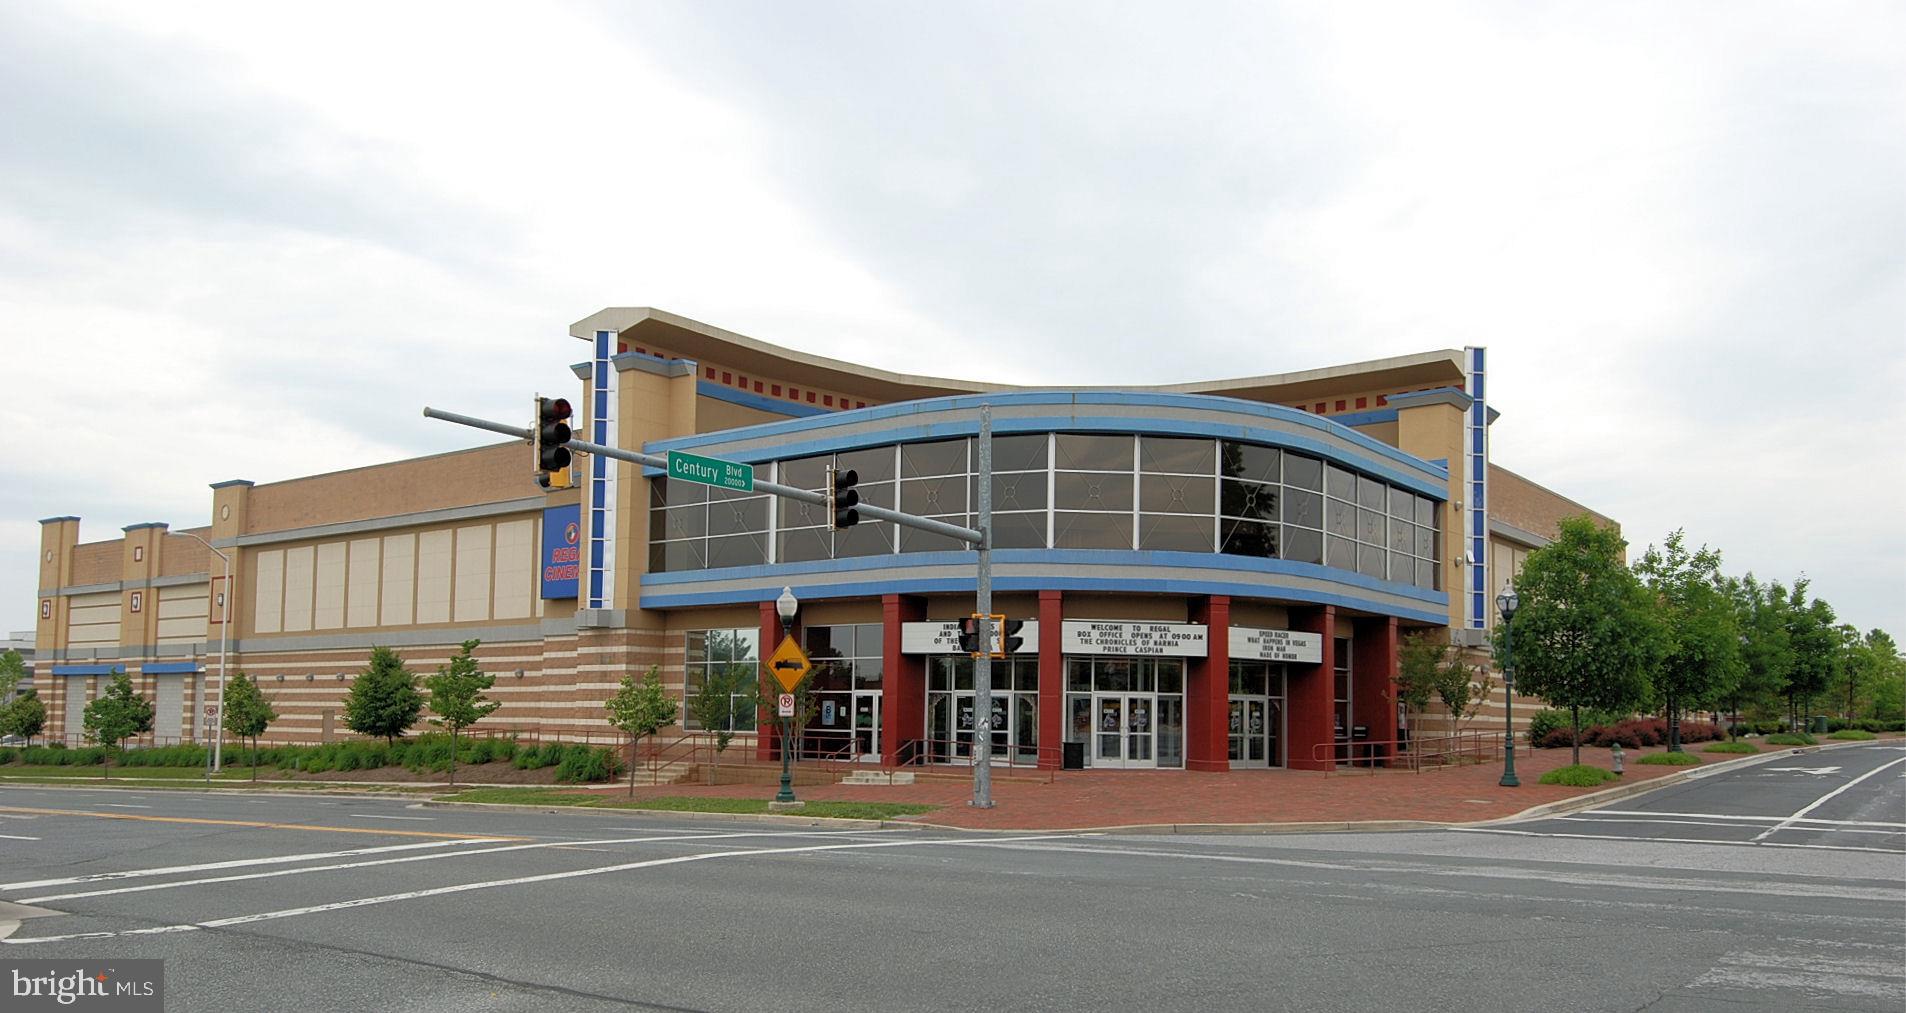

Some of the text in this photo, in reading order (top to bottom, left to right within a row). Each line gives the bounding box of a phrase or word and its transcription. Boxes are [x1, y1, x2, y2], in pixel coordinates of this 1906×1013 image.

[676, 458, 742, 482] Century Blvd
[724, 477, 741, 487] 20000
[1091, 624, 1123, 632] WELCOME
[1149, 625, 1171, 633] REGAL
[1099, 631, 1123, 639] OFFICE
[1159, 632, 1168, 640] AT
[1095, 638, 1137, 646] CHRONICLES
[1134, 646, 1164, 654] CASPIAN
